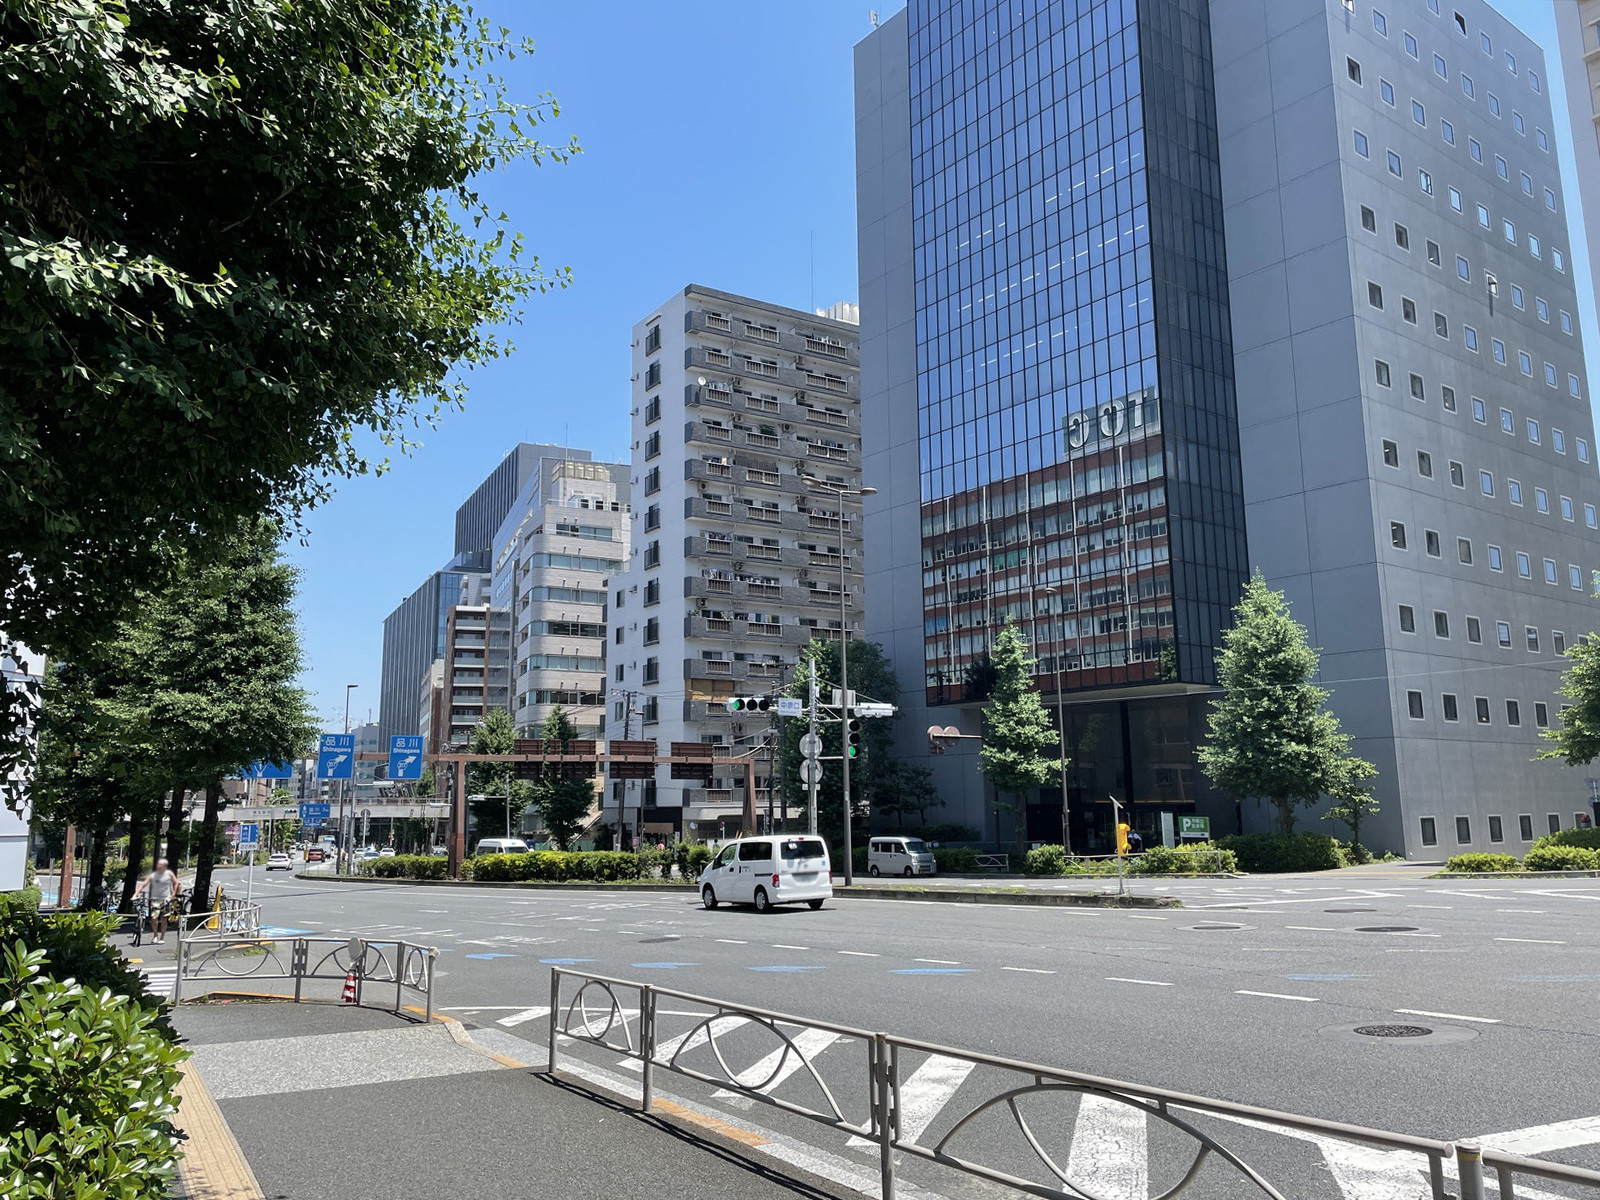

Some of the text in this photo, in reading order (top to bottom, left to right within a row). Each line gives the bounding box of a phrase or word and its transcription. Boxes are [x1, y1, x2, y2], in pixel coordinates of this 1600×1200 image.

[325, 736, 349, 746] 品川
[396, 738, 418, 747] 品川
[1183, 818, 1191, 832] P
